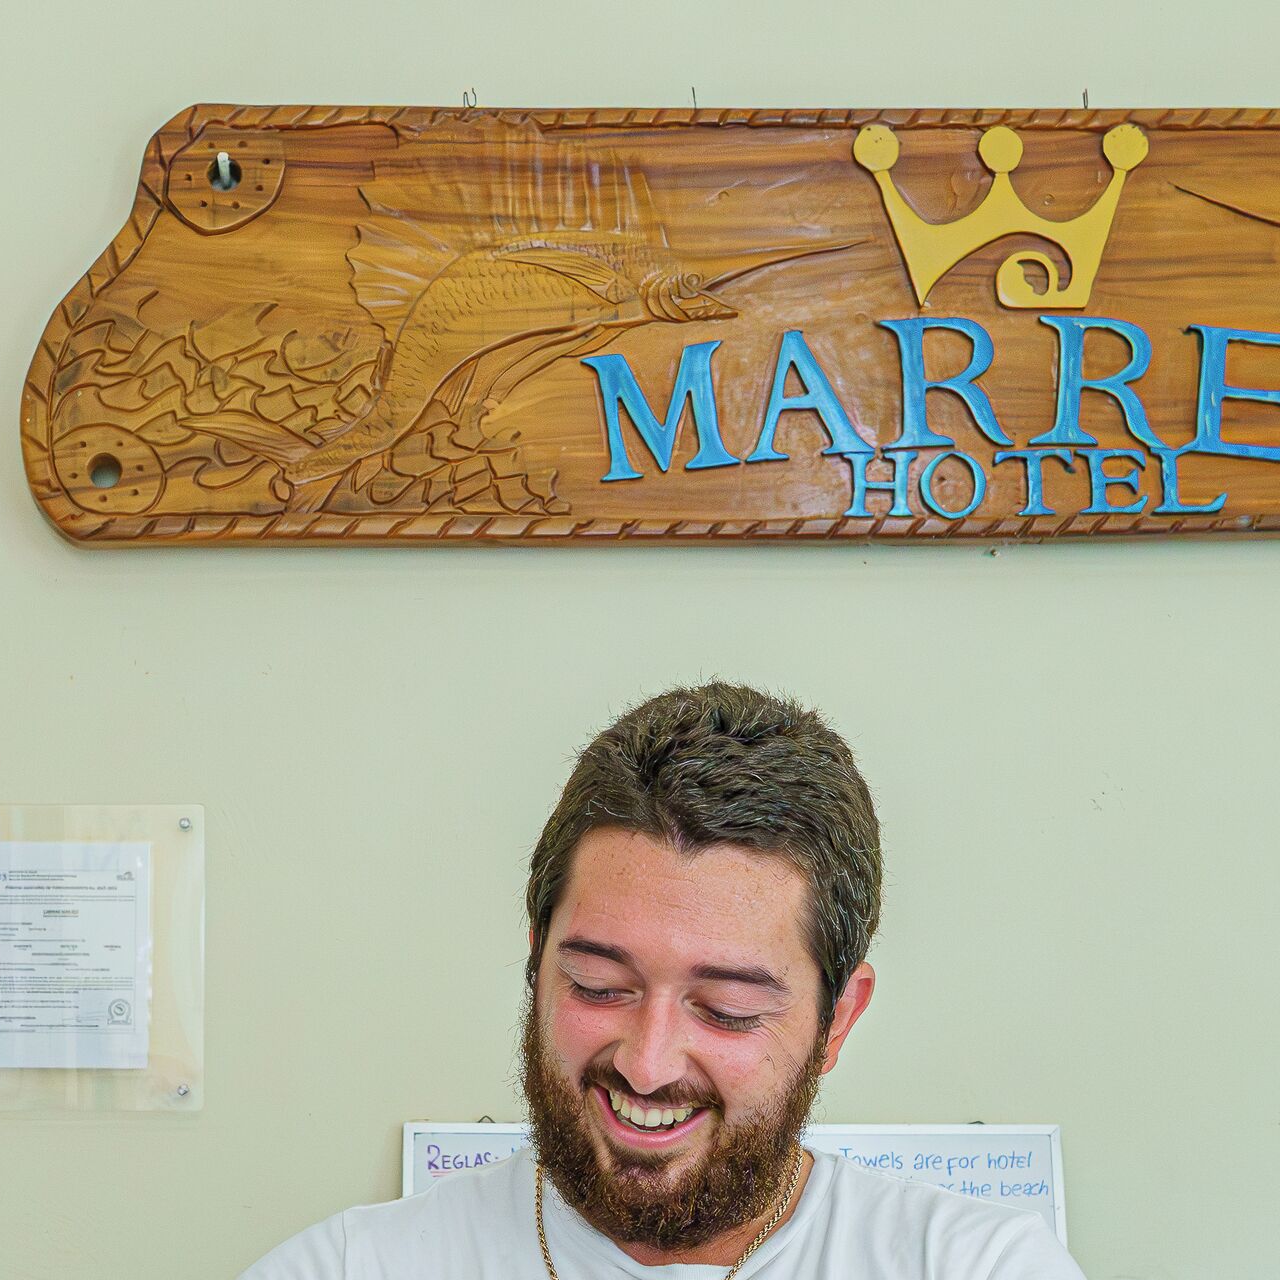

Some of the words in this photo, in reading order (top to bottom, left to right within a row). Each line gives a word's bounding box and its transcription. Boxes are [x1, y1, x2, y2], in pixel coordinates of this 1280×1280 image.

[842, 448, 1228, 520] HOTEL
[913, 1153, 943, 1170] are
[960, 1181, 992, 1197] the
[1000, 1180, 1049, 1197] beach
